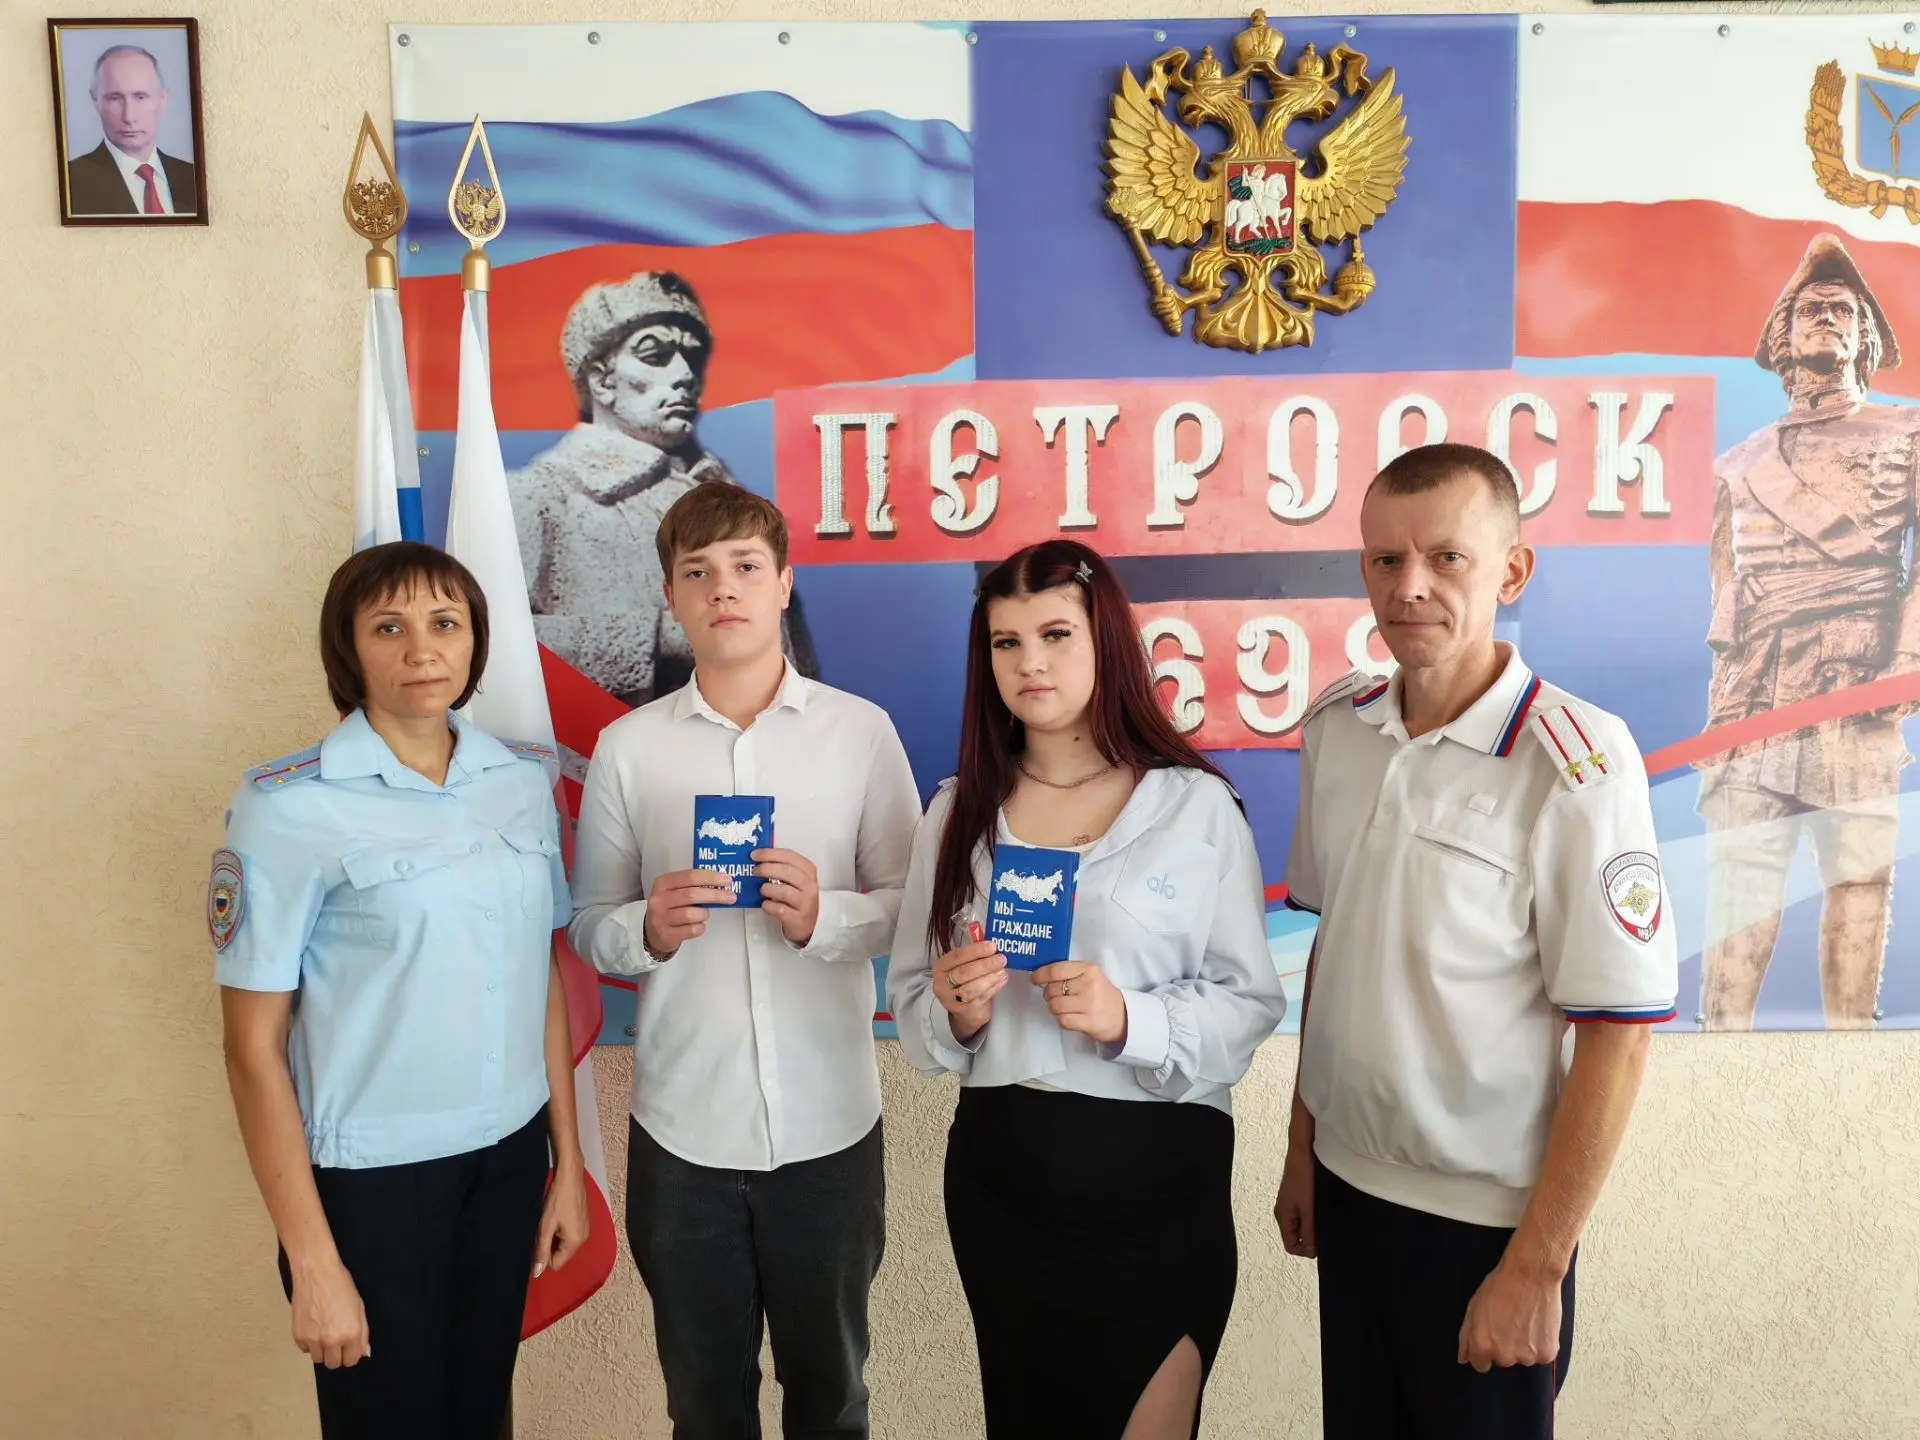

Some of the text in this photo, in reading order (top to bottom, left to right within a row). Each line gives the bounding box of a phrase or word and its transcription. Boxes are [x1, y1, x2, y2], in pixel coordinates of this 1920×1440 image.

[698, 847, 717, 860] МЫ
[993, 900, 1014, 916] МЫ
[992, 918, 1053, 940] ГРАЖДАНЕ
